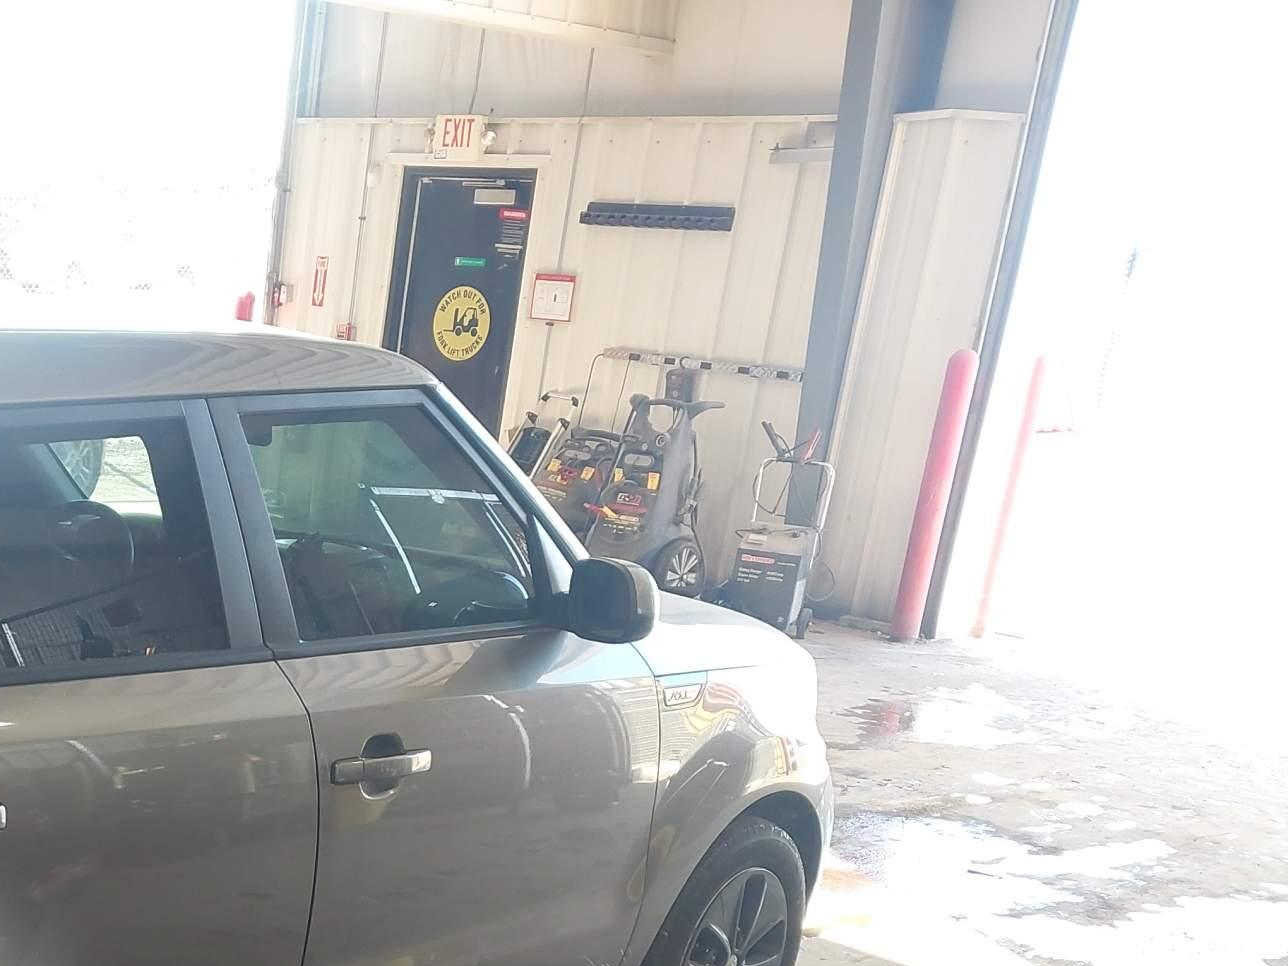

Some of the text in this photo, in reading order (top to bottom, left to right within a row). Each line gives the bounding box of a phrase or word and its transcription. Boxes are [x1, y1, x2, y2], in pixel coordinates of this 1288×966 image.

[442, 118, 476, 148] EXIT
[439, 289, 487, 316] WATCH OUT FOR
[436, 330, 483, 357] FORK LIFT TRUCKS
